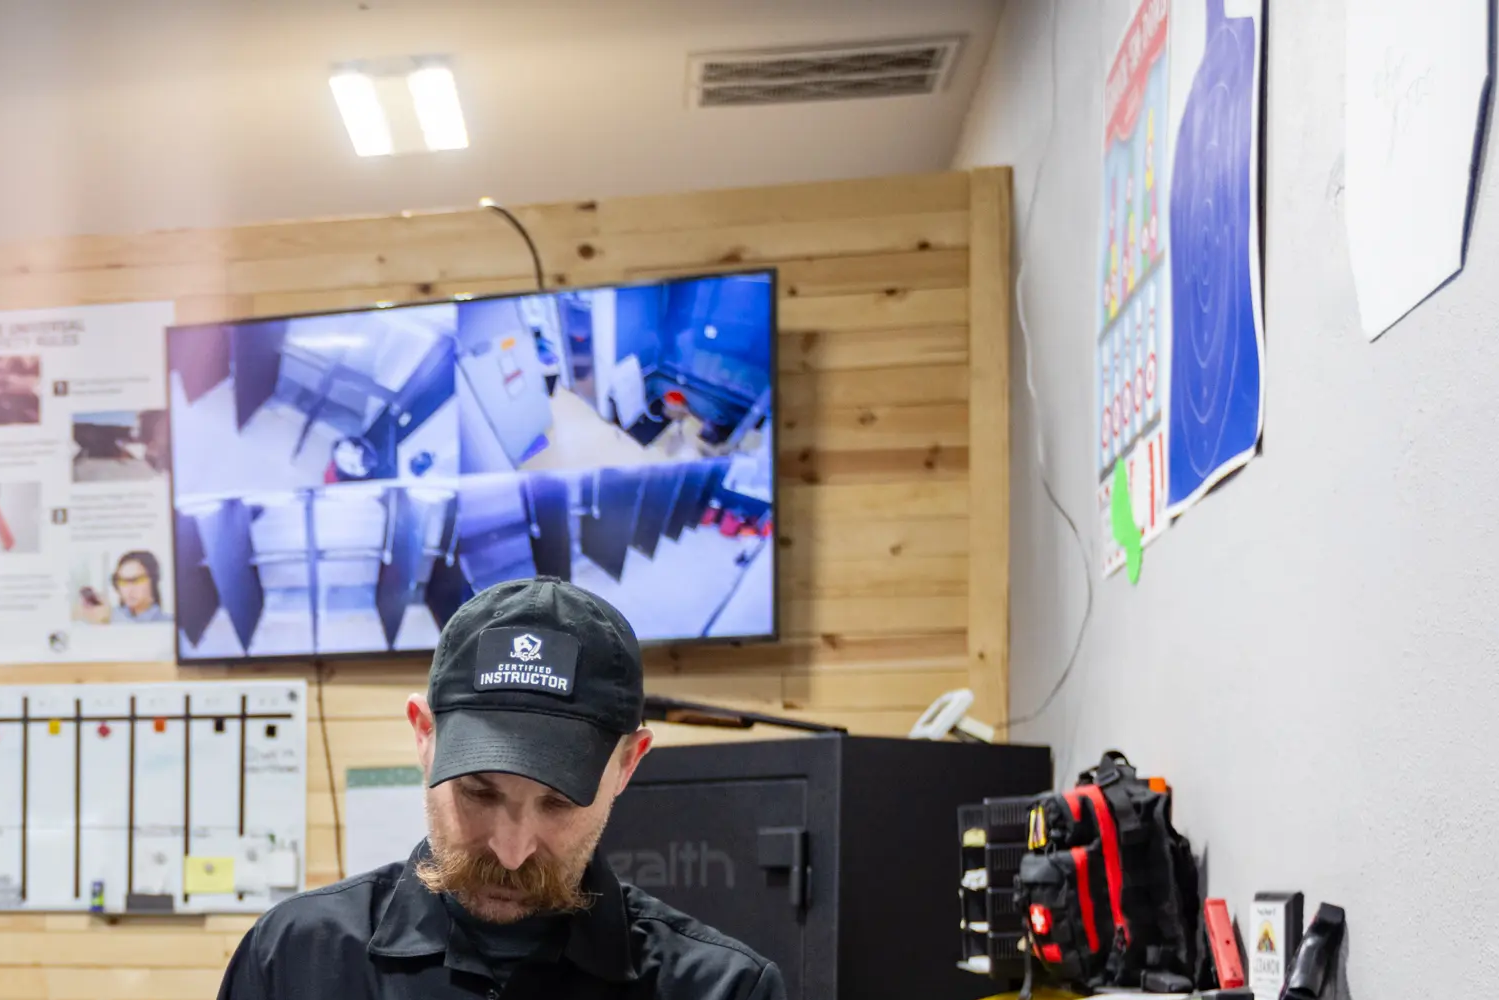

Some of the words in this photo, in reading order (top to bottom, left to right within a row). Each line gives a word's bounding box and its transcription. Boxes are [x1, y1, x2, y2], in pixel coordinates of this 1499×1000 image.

[509, 651, 542, 660] USCCA
[498, 663, 552, 675] CERTIFIED
[480, 671, 568, 691] INSTRUCTOR
[606, 840, 736, 888] ealth
